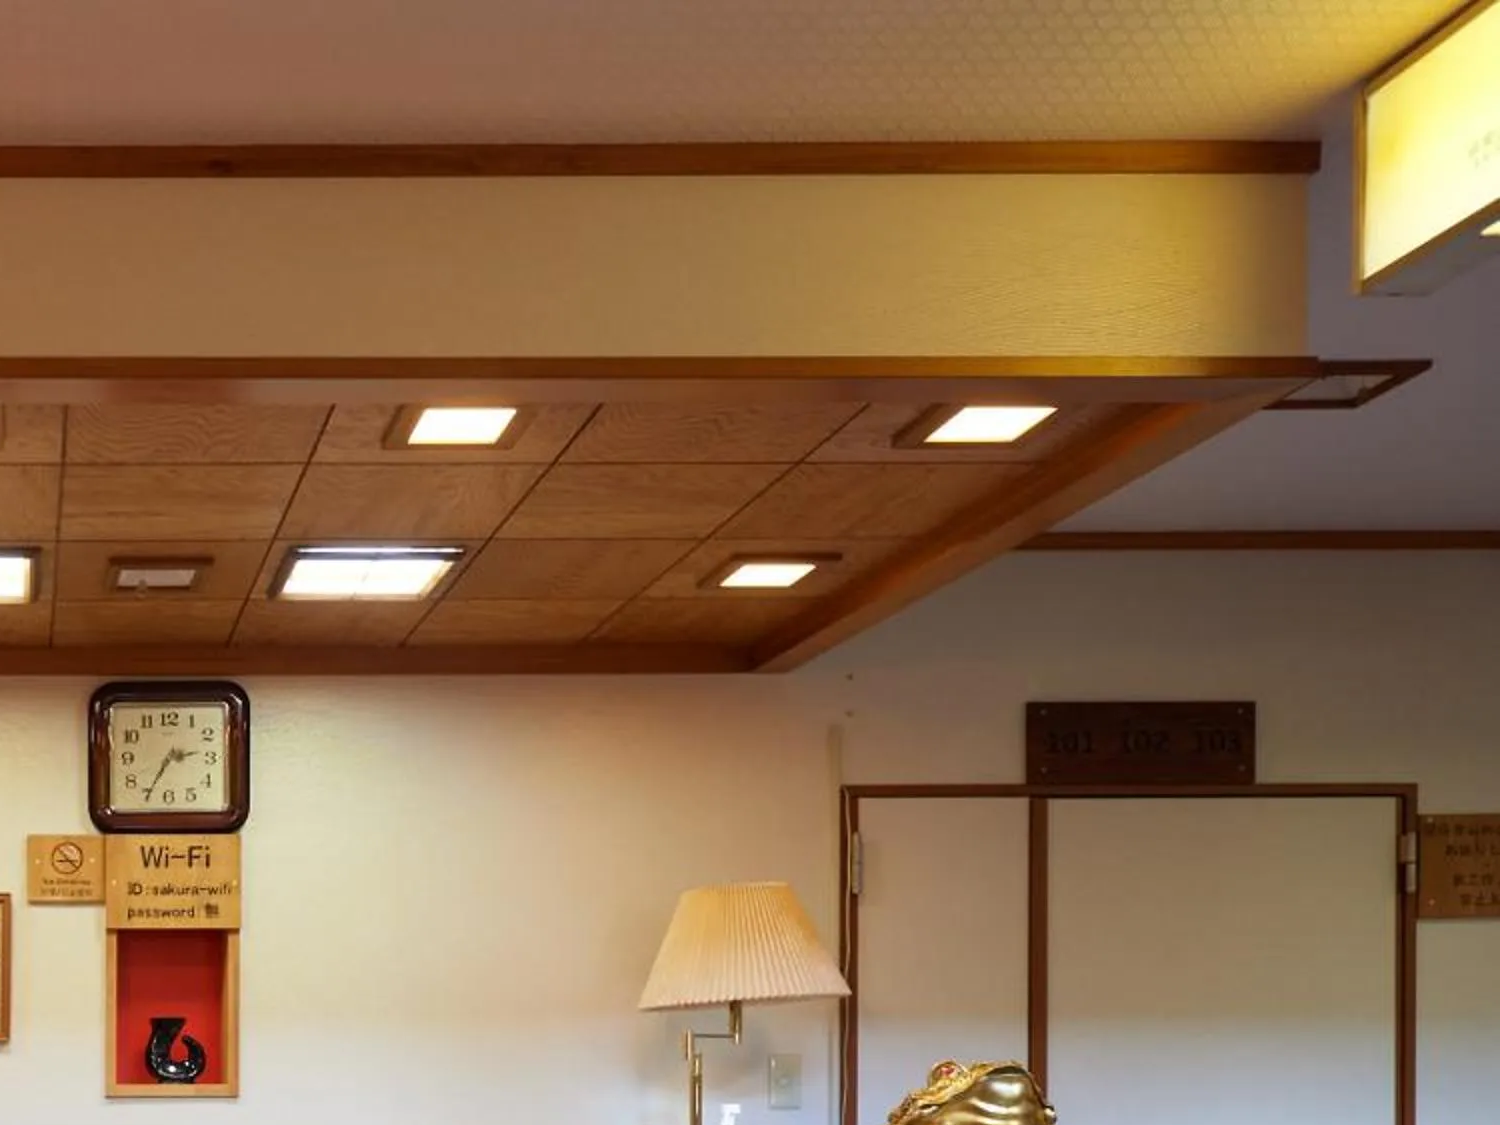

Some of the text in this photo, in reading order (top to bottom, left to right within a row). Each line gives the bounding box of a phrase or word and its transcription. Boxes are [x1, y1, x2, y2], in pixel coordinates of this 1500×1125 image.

[141, 714, 153, 729] 11
[161, 712, 179, 727] 12
[188, 714, 195, 729] 1
[124, 729, 139, 744] 10
[201, 727, 214, 742] 2
[1120, 729, 1171, 754] 102
[121, 751, 135, 766] 9
[204, 751, 217, 765] 3
[125, 773, 137, 789] 8
[199, 773, 211, 788] 4
[142, 788, 152, 802] 7
[163, 789, 175, 804] 6
[185, 787, 197, 802] 5
[140, 845, 211, 869] Wi-Fi
[127, 905, 195, 920] password
